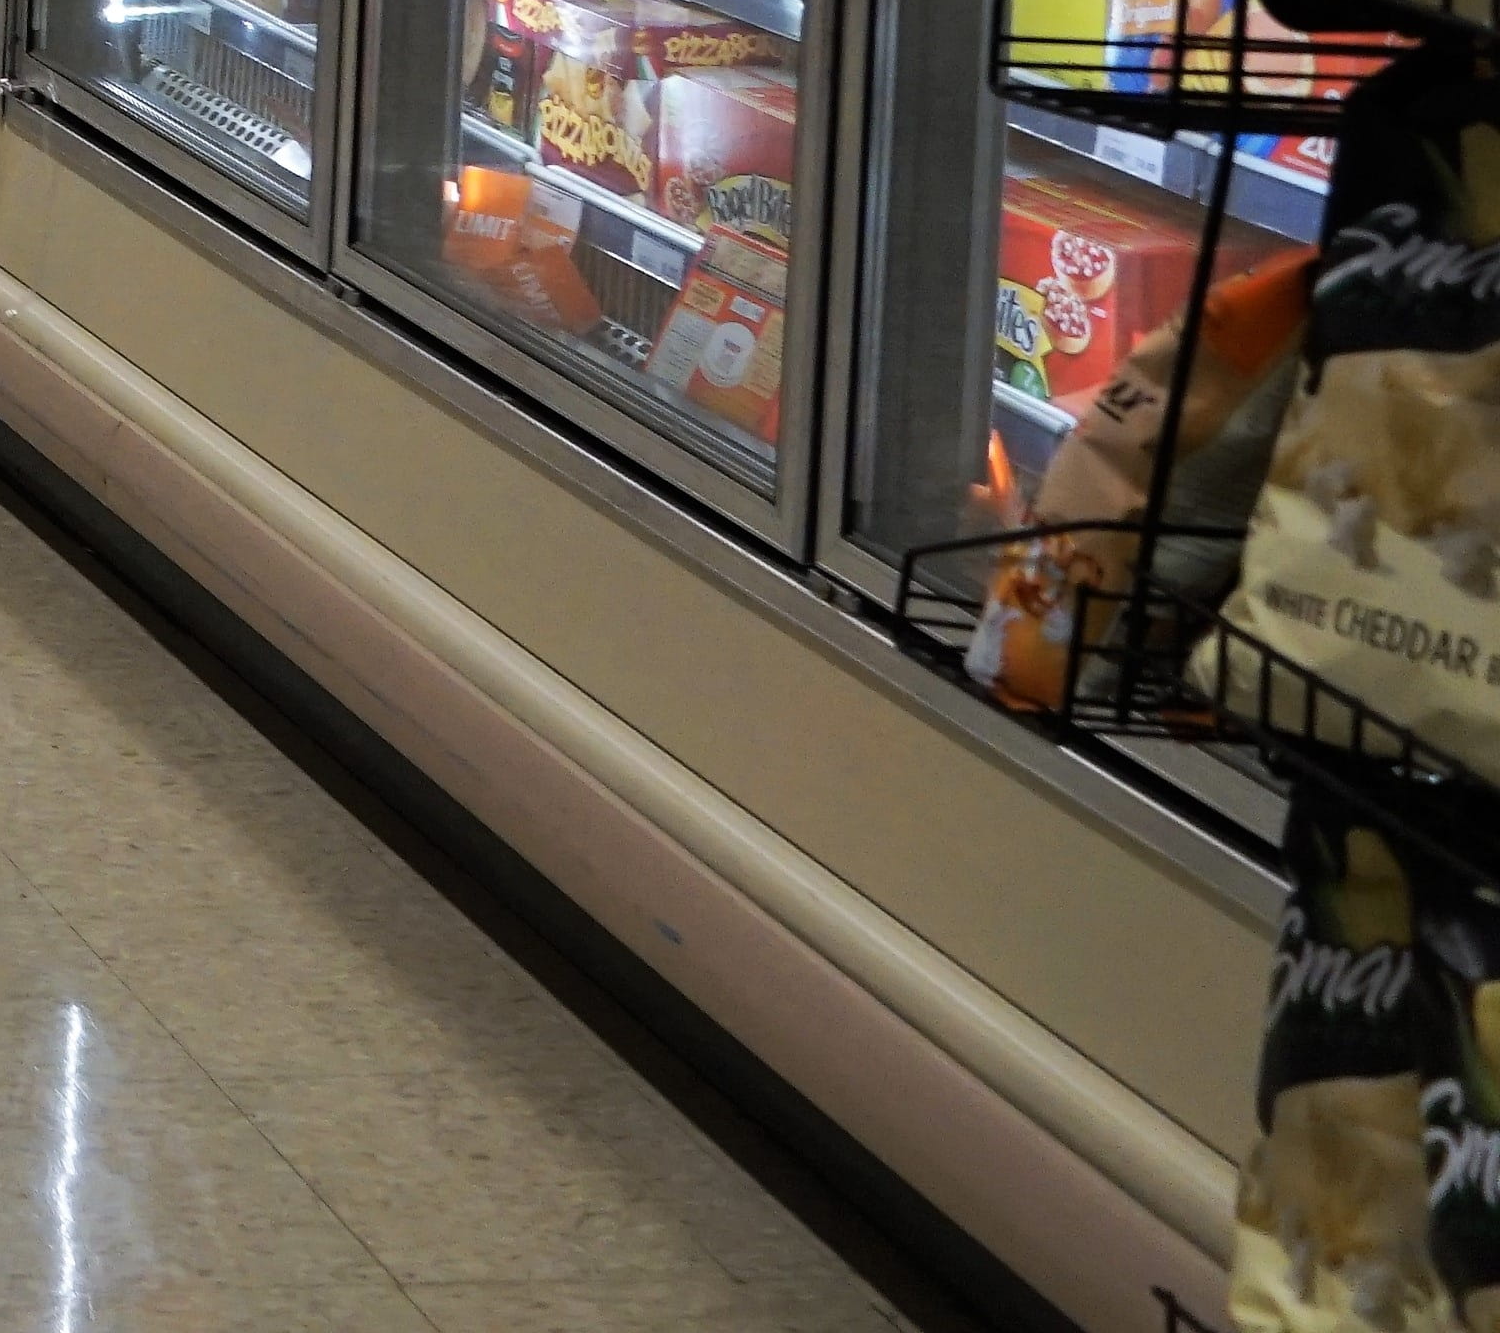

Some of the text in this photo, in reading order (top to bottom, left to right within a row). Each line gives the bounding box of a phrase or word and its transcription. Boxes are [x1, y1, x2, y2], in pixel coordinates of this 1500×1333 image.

[709, 174, 761, 226] Bagel
[998, 287, 1039, 357] ites
[1265, 582, 1480, 674] WHITE CHEDDAR
